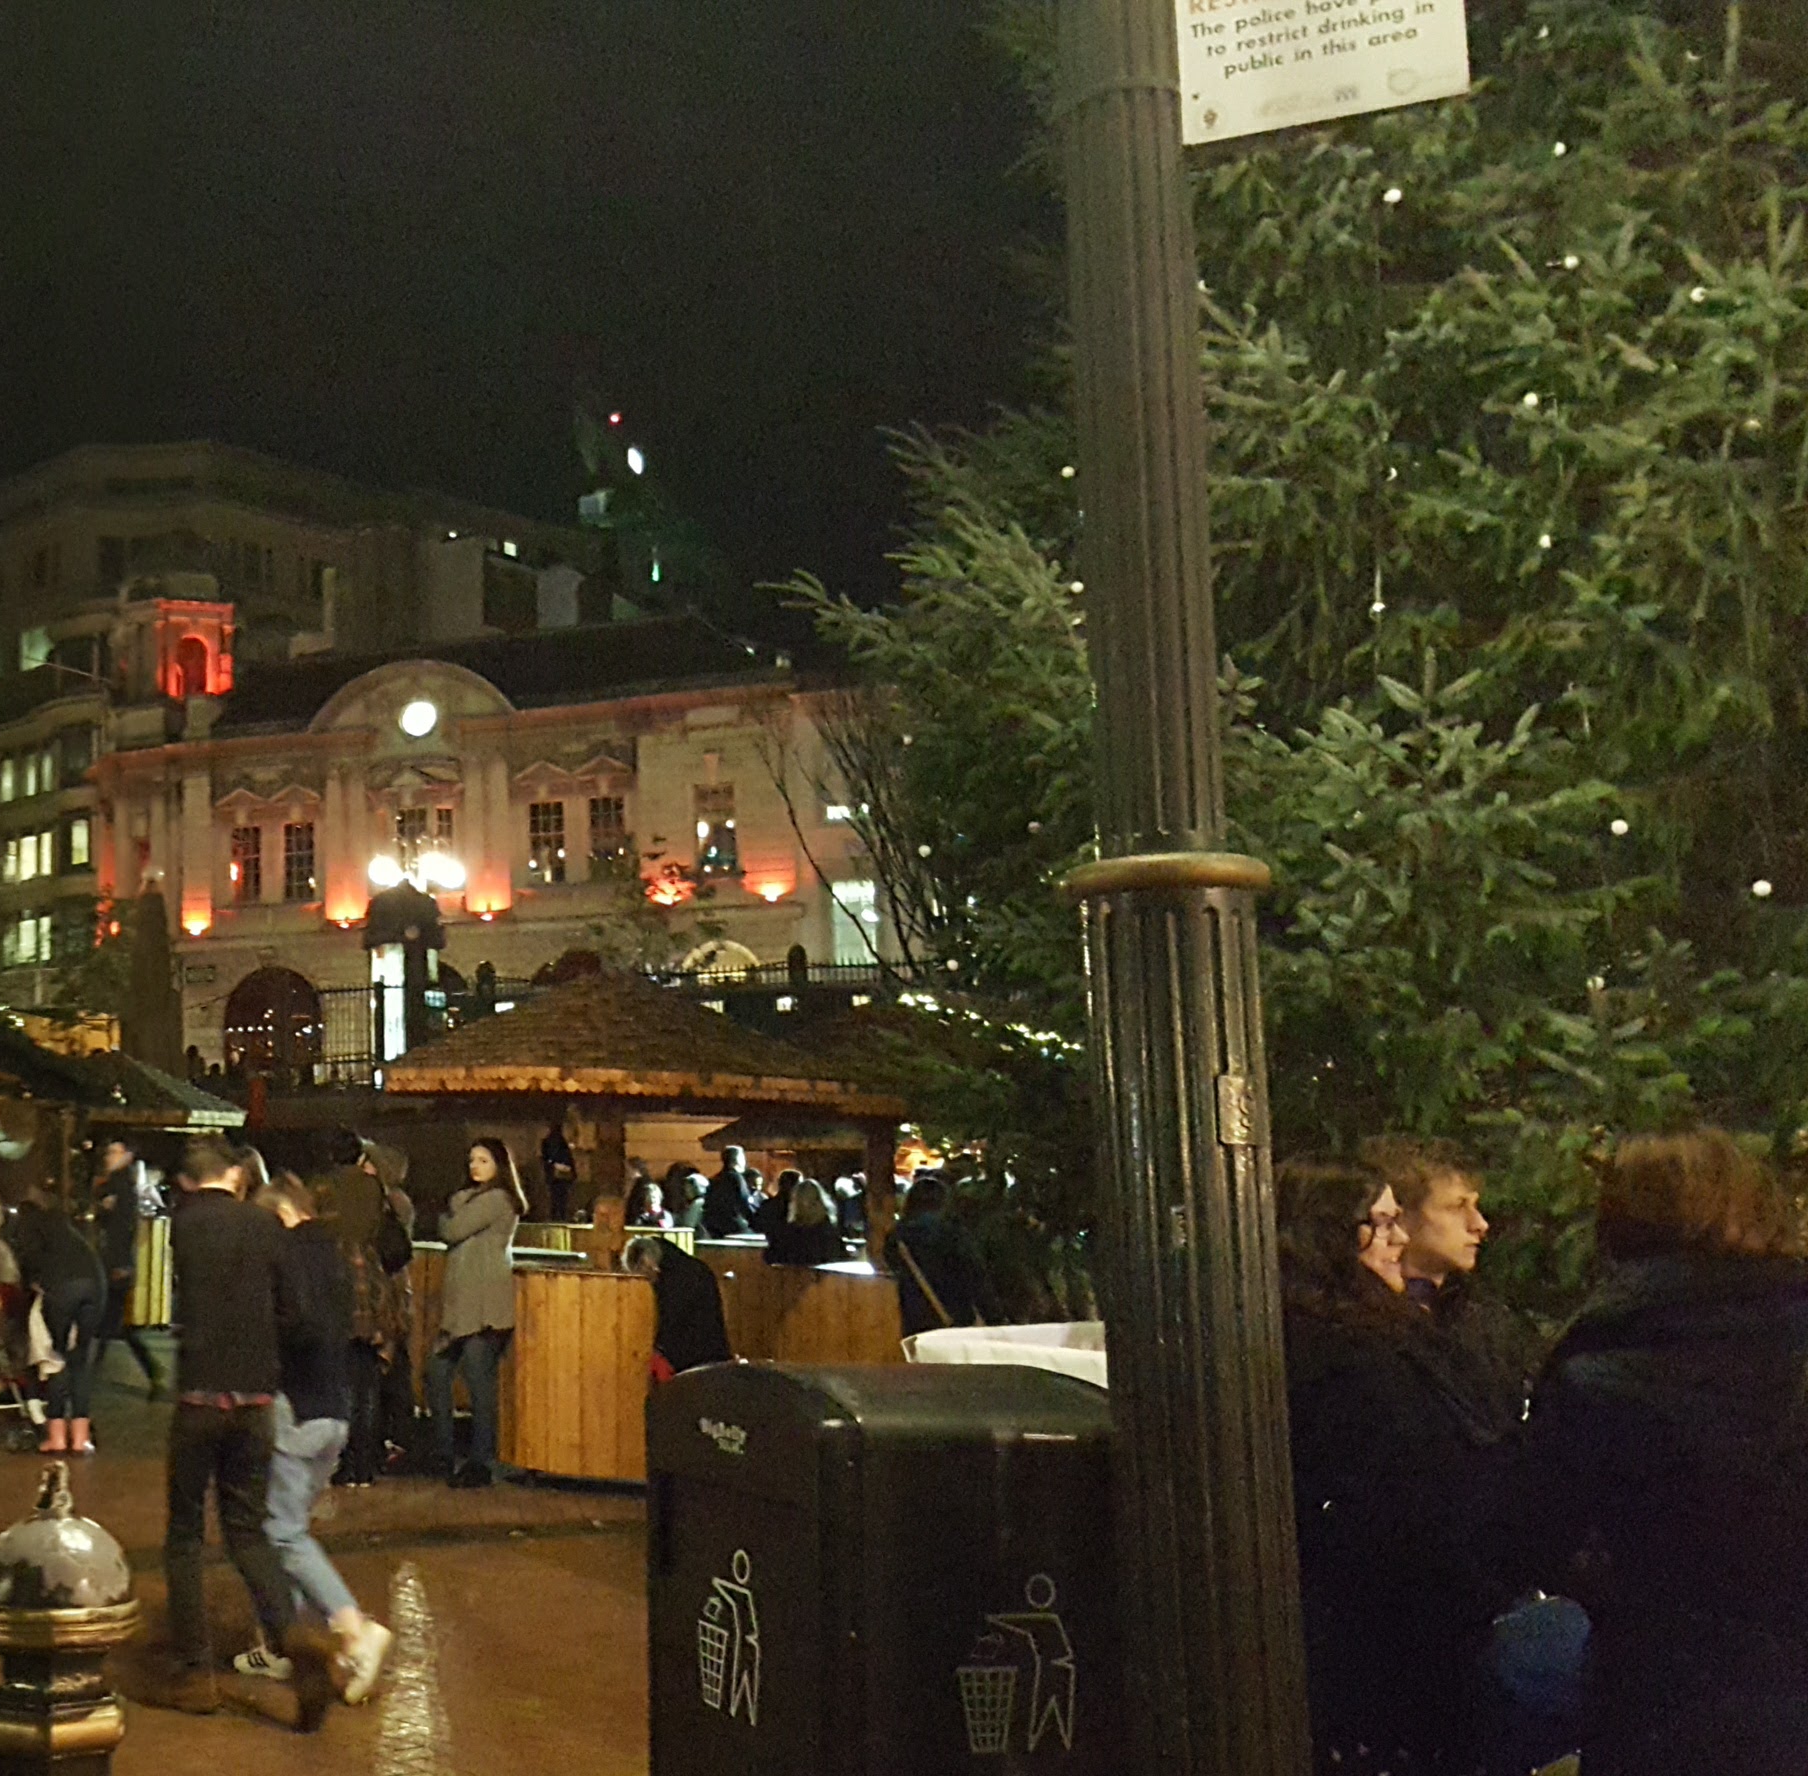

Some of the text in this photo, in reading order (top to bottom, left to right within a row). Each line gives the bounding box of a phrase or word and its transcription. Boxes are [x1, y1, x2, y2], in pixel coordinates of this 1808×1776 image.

[1191, 22, 1225, 39] The
[1236, 8, 1296, 33] police
[1207, 2, 1434, 56] to restrict drinking in
[1224, 28, 1417, 79] public in this area
